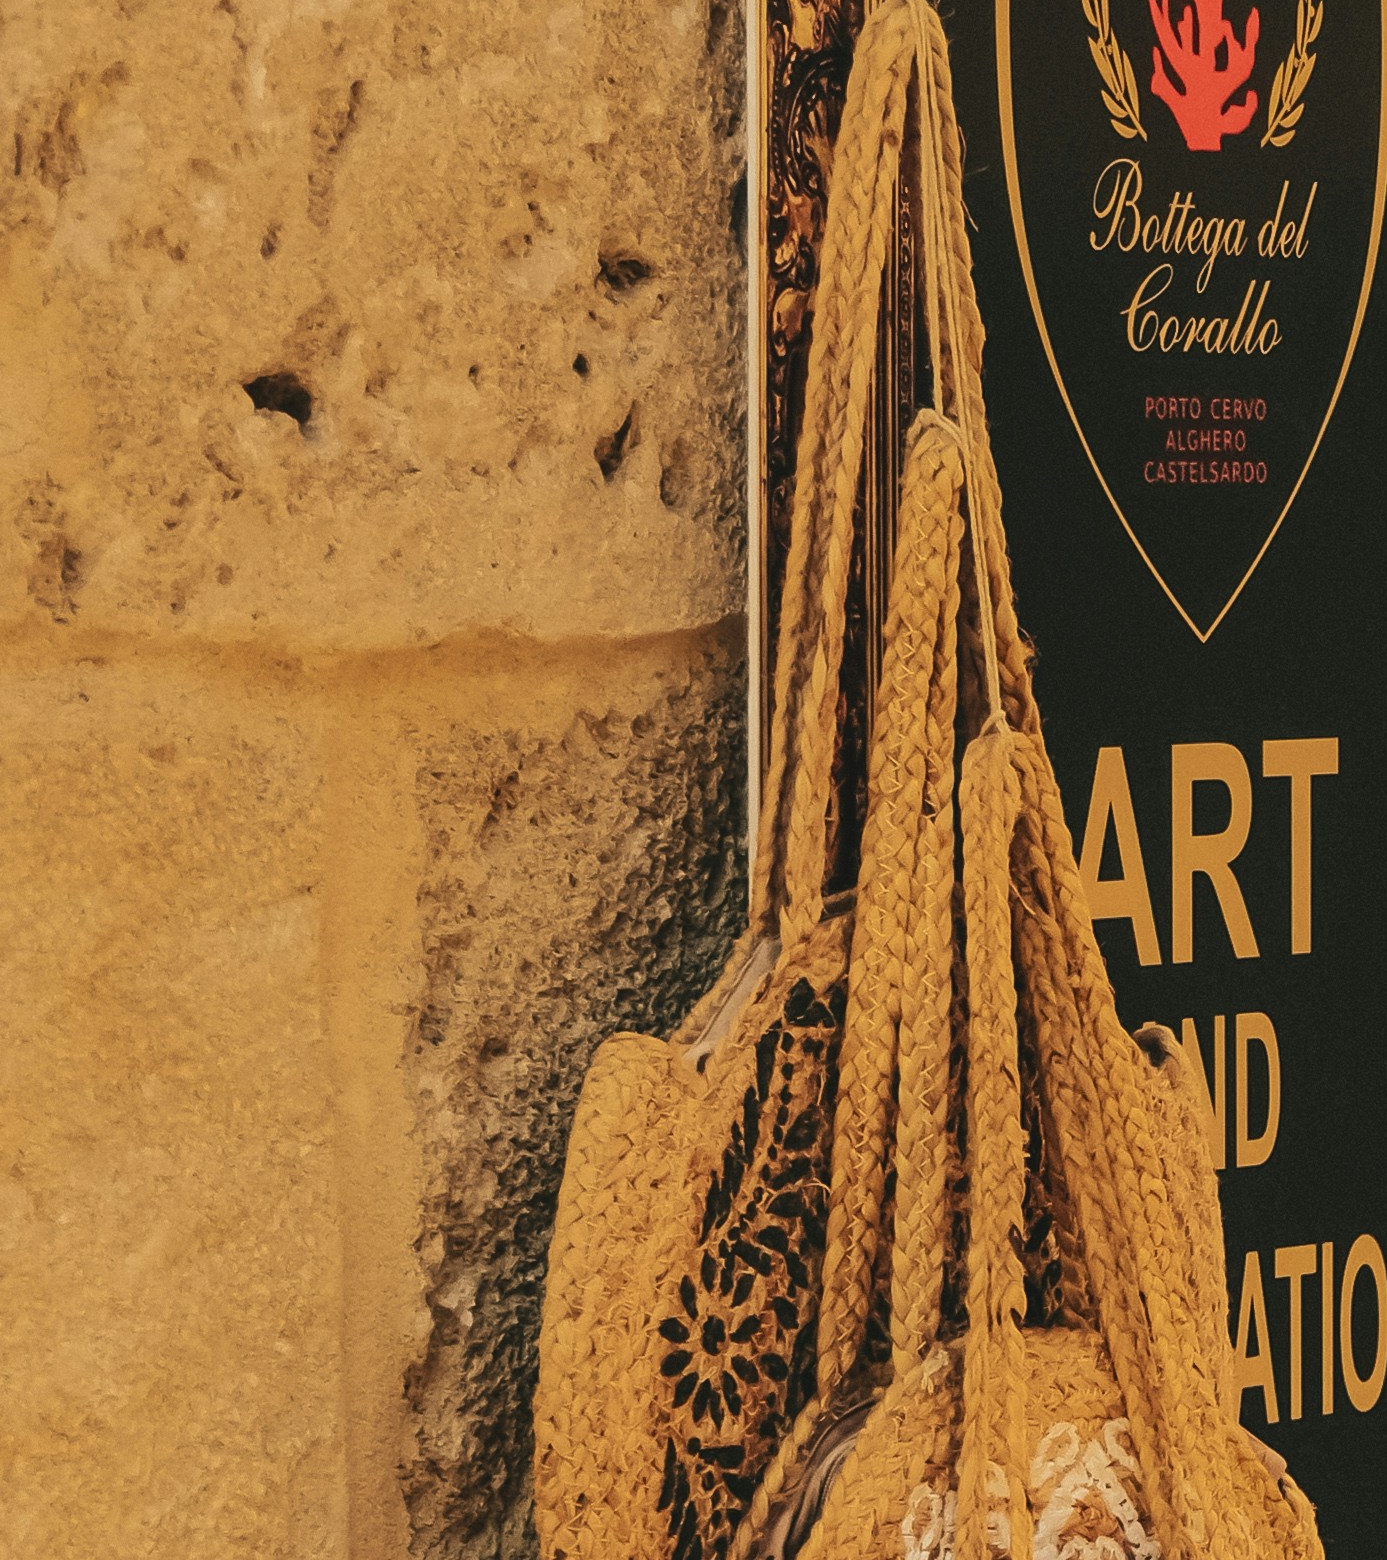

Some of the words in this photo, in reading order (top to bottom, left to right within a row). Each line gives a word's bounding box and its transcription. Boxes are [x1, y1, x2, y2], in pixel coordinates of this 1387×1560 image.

[1088, 157, 1248, 293] Bottega
[1257, 179, 1318, 259] del
[1120, 263, 1283, 355] Corallo
[1145, 396, 1200, 420] PORTO
[1210, 398, 1267, 421] CERVO
[1165, 429, 1246, 452] ALGHERO
[1143, 461, 1267, 483] CASTELSARDO
[1076, 735, 1340, 967] ART
[1160, 1010, 1282, 1171] ND
